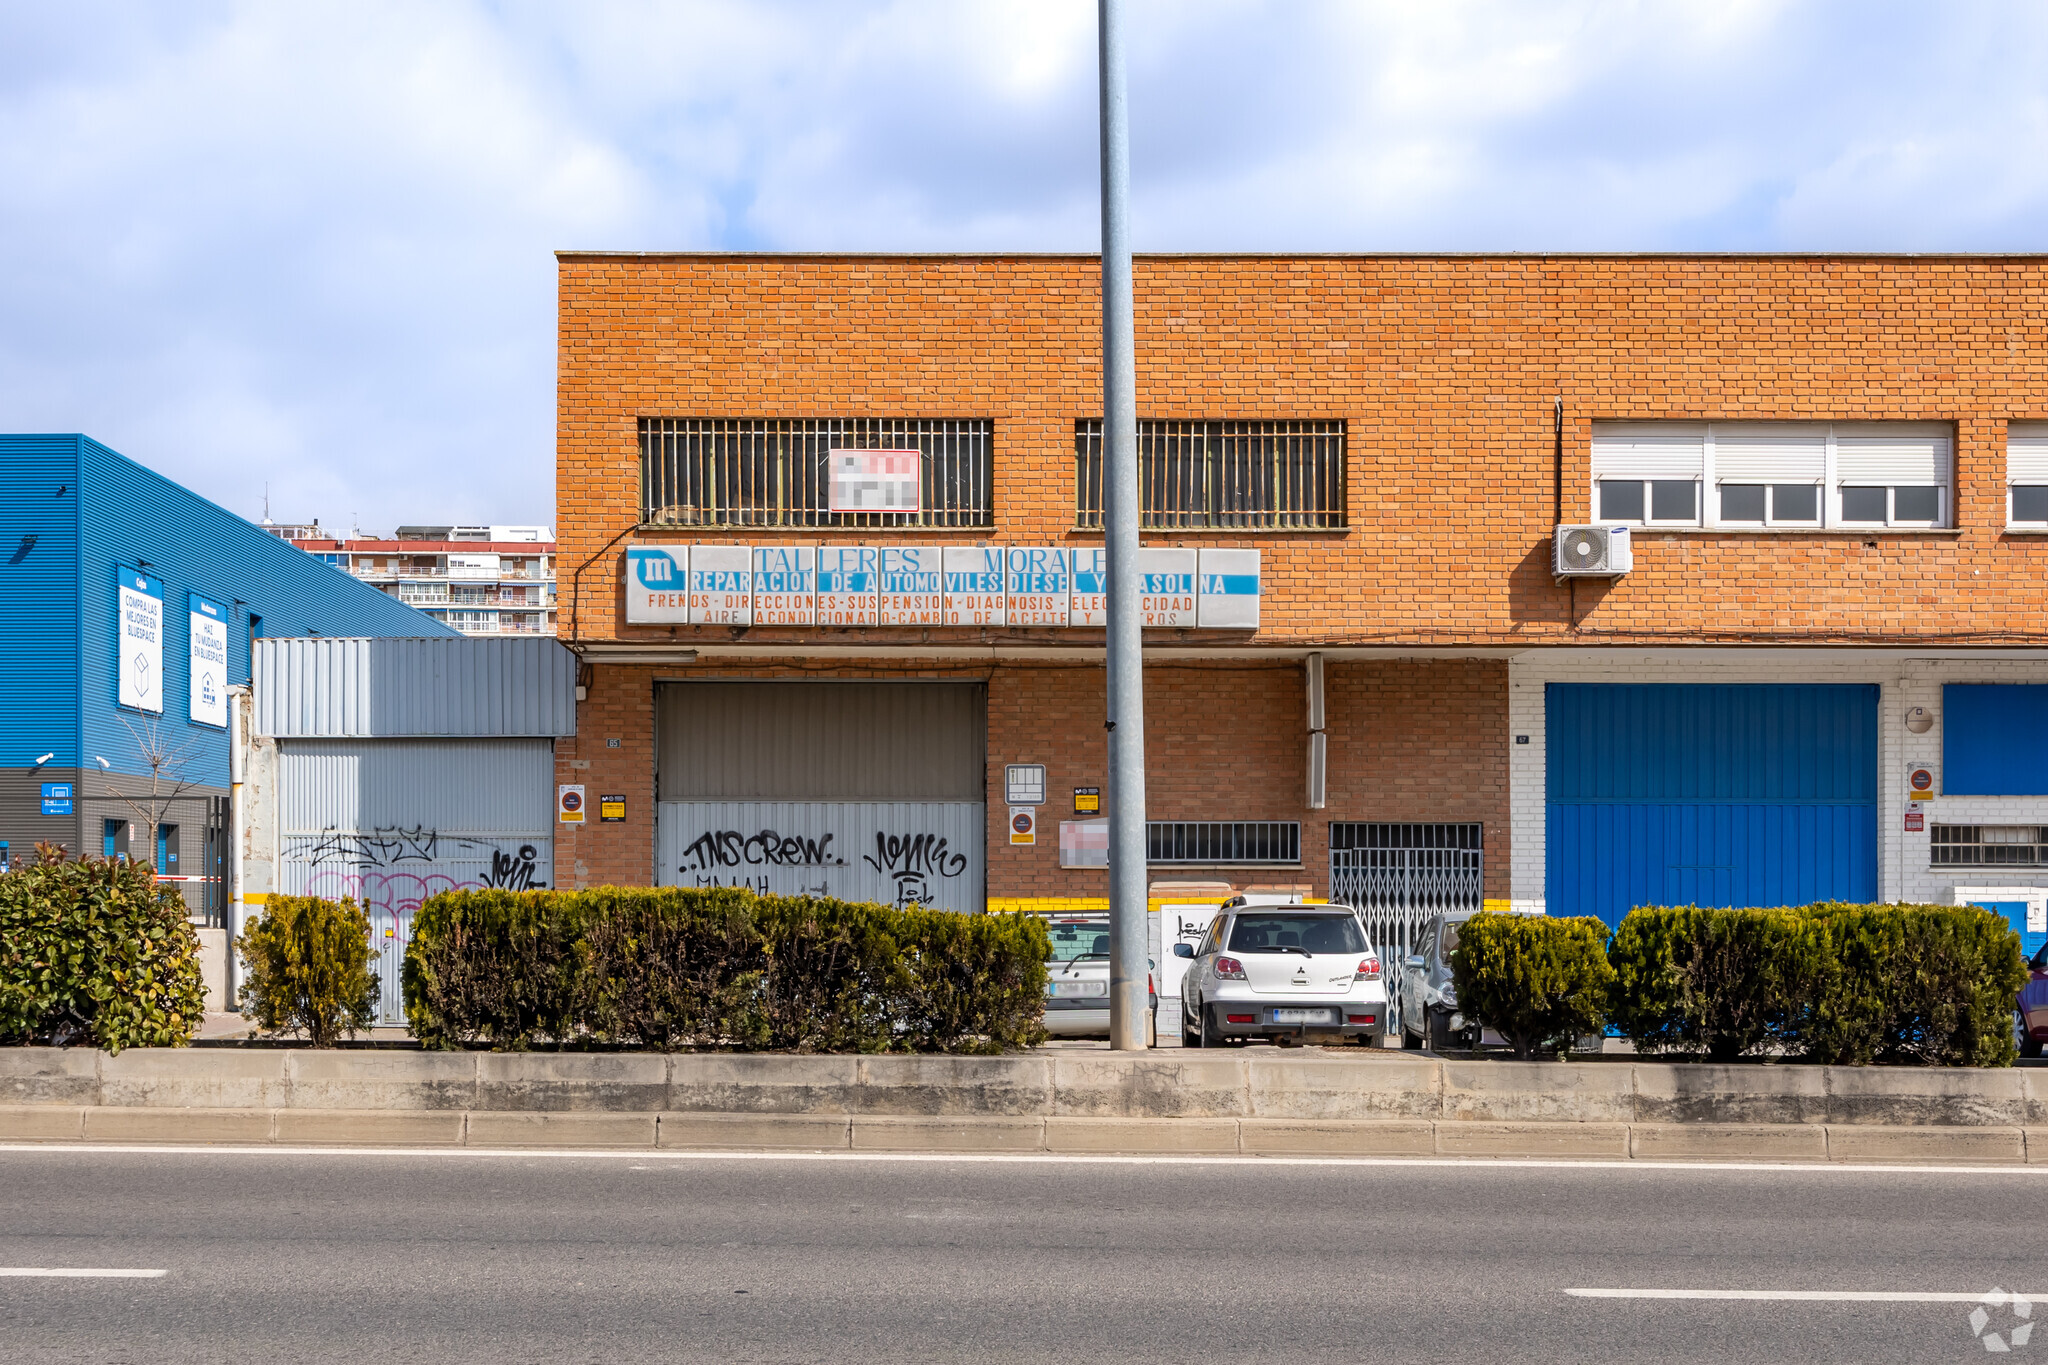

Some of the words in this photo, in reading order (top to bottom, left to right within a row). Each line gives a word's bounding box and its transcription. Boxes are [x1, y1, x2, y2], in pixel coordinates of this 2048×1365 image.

[755, 548, 920, 571] TALLERES
[984, 549, 1106, 573] MORALE
[691, 572, 813, 592] REPARACION
[832, 573, 853, 592] DE
[1093, 574, 1106, 593] Y
[1139, 574, 1226, 593] ASOLINA
[126, 594, 147, 612] COMPRA
[148, 603, 157, 616] LAS
[648, 594, 710, 609] FRENOS
[126, 609, 149, 627] MEJORES
[149, 617, 157, 630] EN
[703, 610, 739, 624] AIRE
[973, 611, 992, 625] DE
[1083, 612, 1093, 625] Y
[128, 624, 155, 644] BLUESPACE
[204, 623, 213, 635] HAZ
[609, 739, 618, 747] 65
